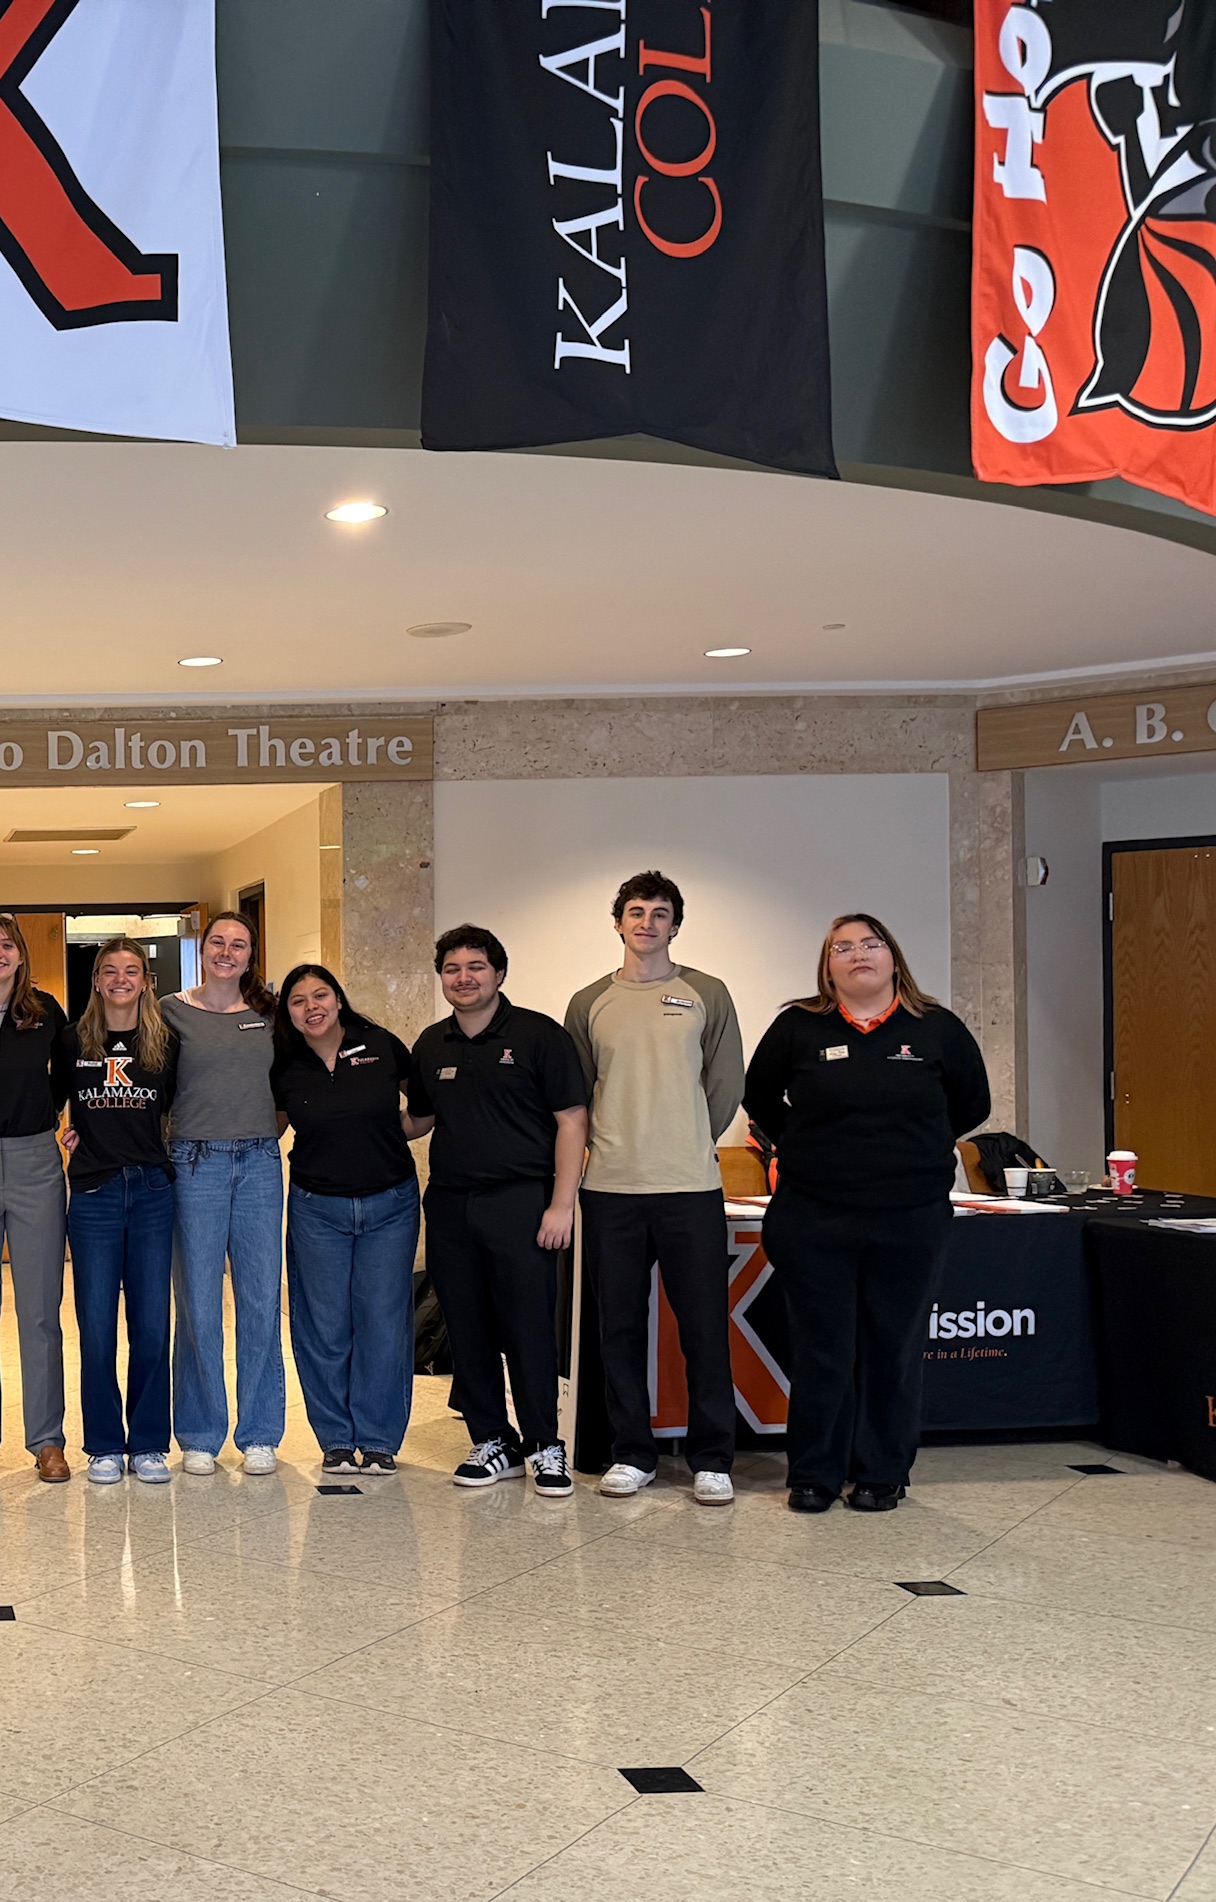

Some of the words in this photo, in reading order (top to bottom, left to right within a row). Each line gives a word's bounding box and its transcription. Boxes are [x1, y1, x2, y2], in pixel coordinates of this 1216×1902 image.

[1058, 711, 1114, 751] A.
[1135, 702, 1184, 744] B.
[47, 727, 207, 771] Dalton
[228, 725, 414, 767] Theatre
[103, 1057, 133, 1087] K
[78, 1087, 157, 1101] KALAMAZOO
[87, 1098, 146, 1109] COLLEGE
[929, 1301, 1035, 1339] ission
[937, 1348, 948, 1359] in
[960, 1346, 1008, 1361] Lifetime.
